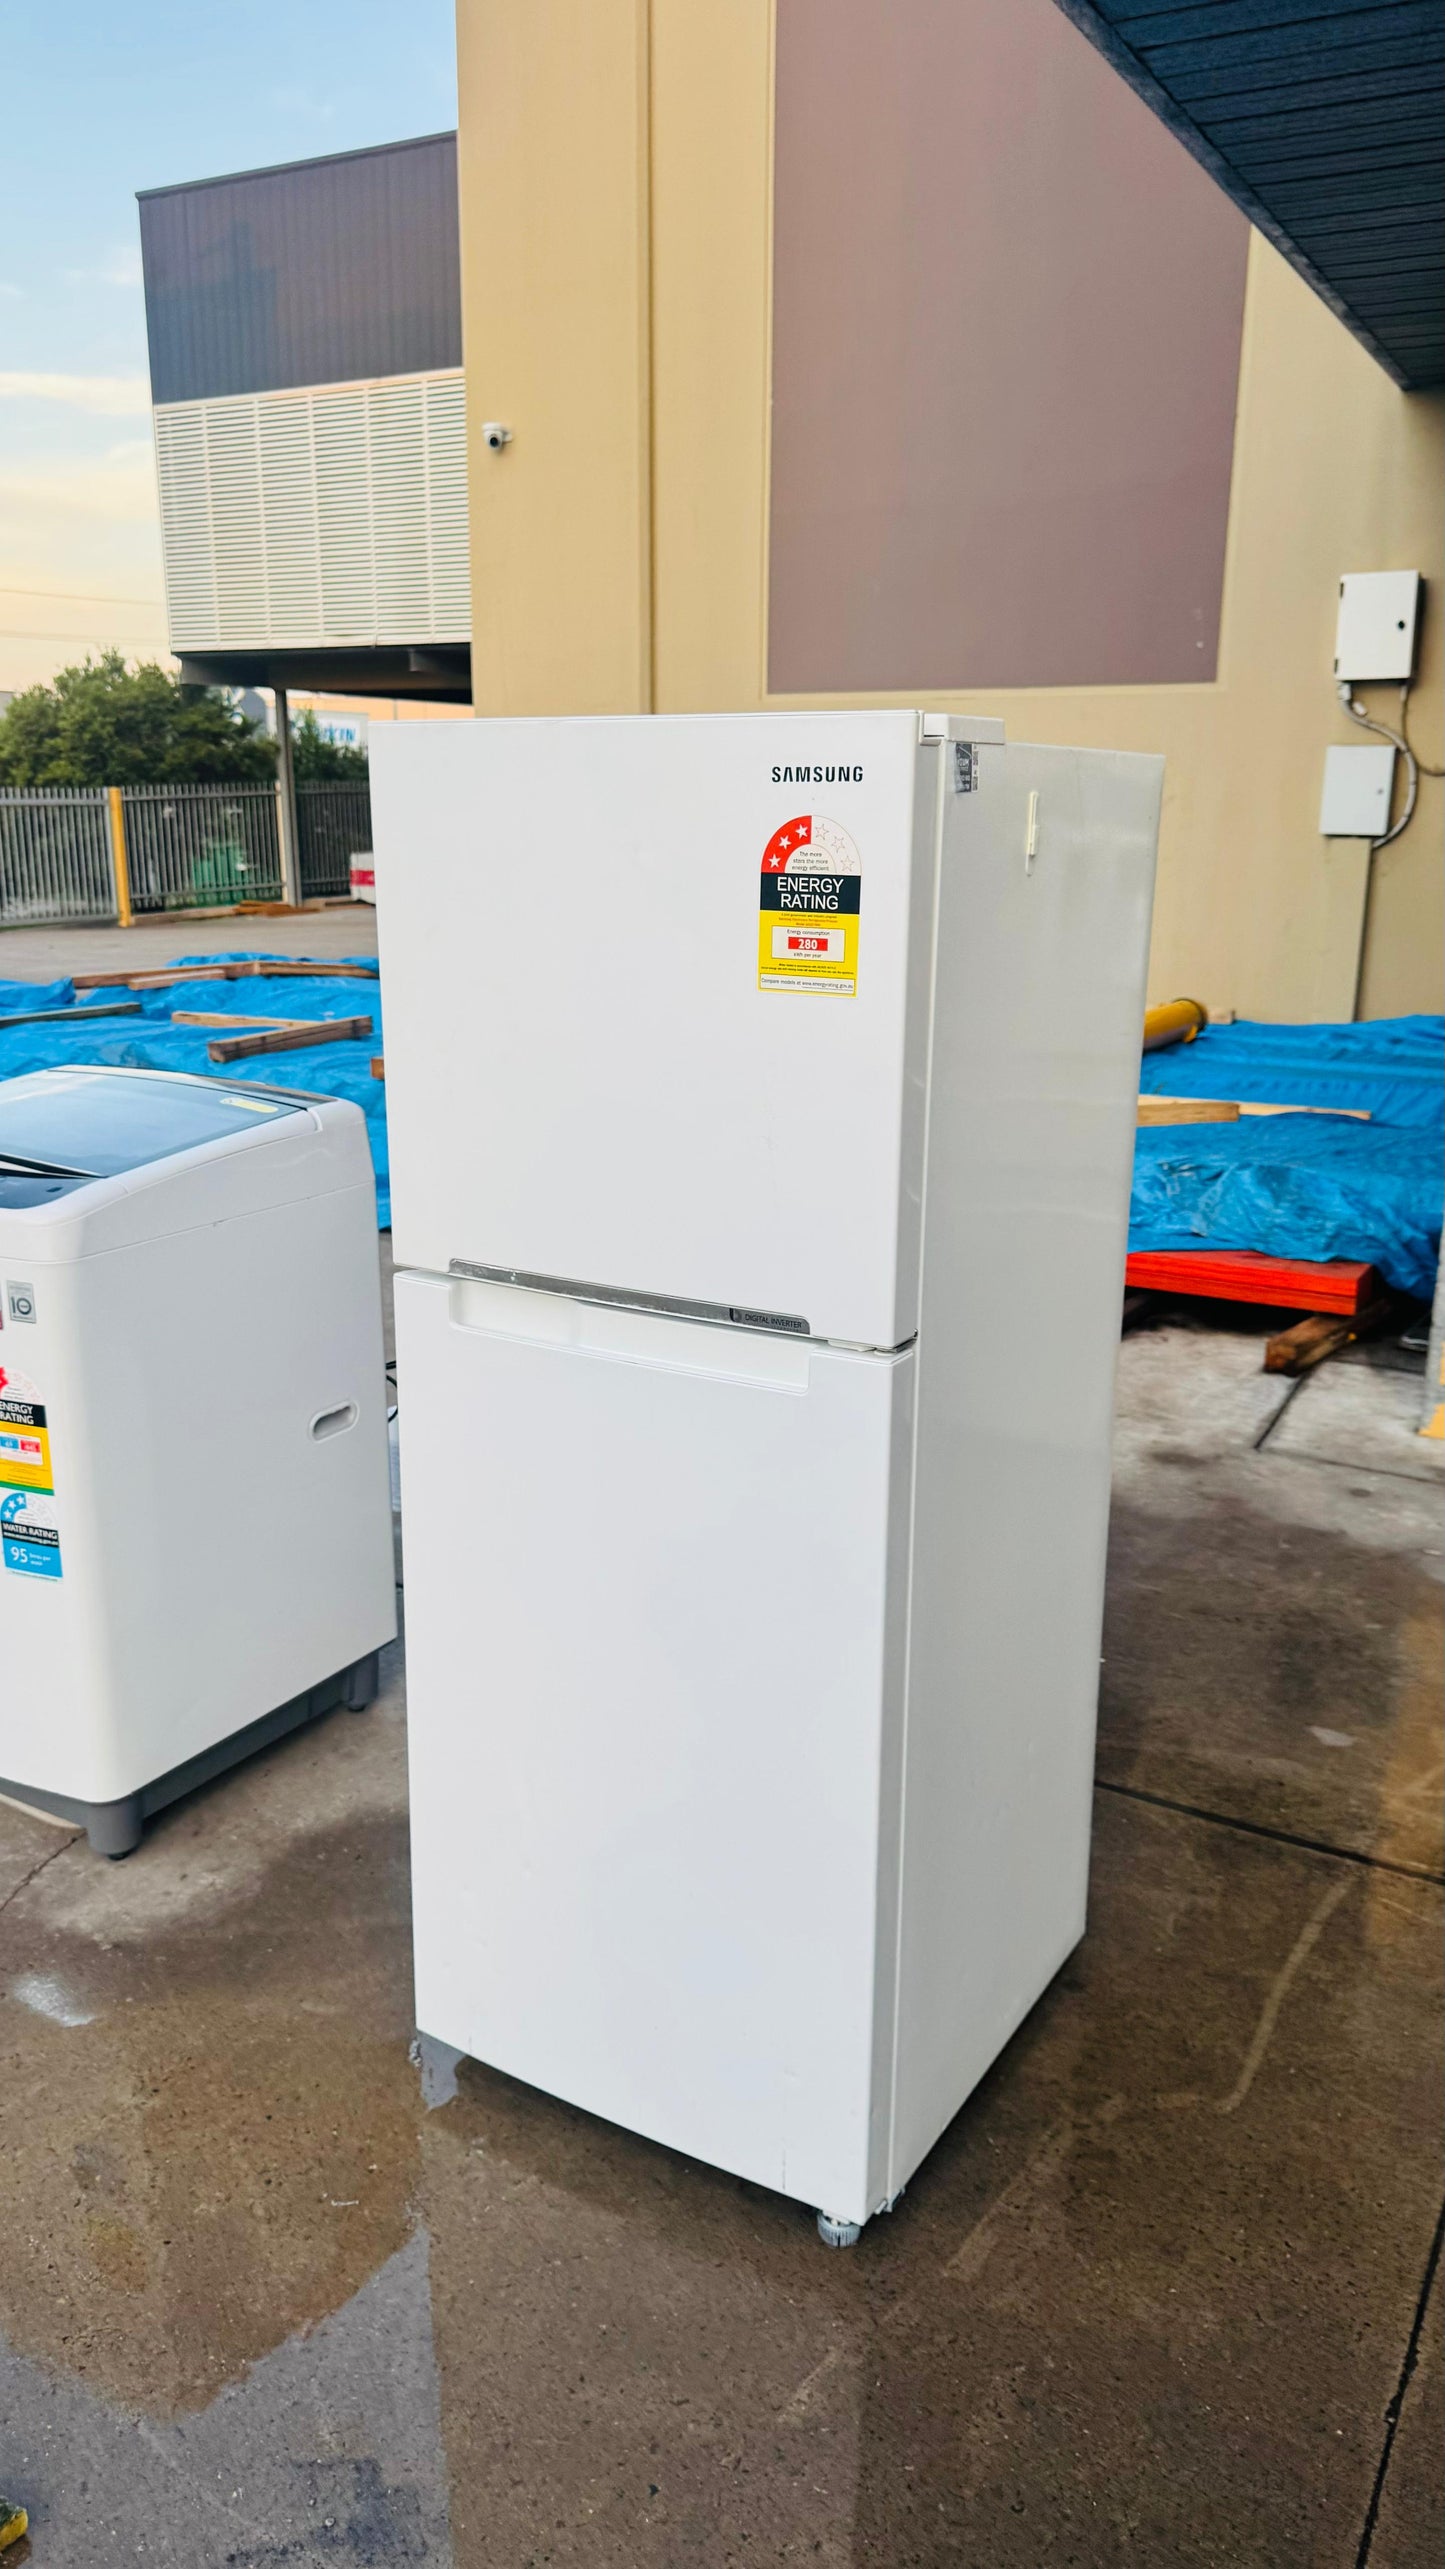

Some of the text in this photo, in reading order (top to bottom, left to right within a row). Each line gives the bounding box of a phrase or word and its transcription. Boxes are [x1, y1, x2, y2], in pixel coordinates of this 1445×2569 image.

[771, 766, 863, 783] SAMSUNG
[777, 876, 844, 894] ENERGY
[780, 893, 839, 910] RATING
[798, 938, 818, 950] 280
[761, 977, 780, 985] Compare
[11, 1296, 32, 1315] 10
[744, 1313, 802, 1328] DIGITAL INVERTER
[3, 1522, 58, 1540] WATER RATING
[10, 1546, 28, 1563] 95
